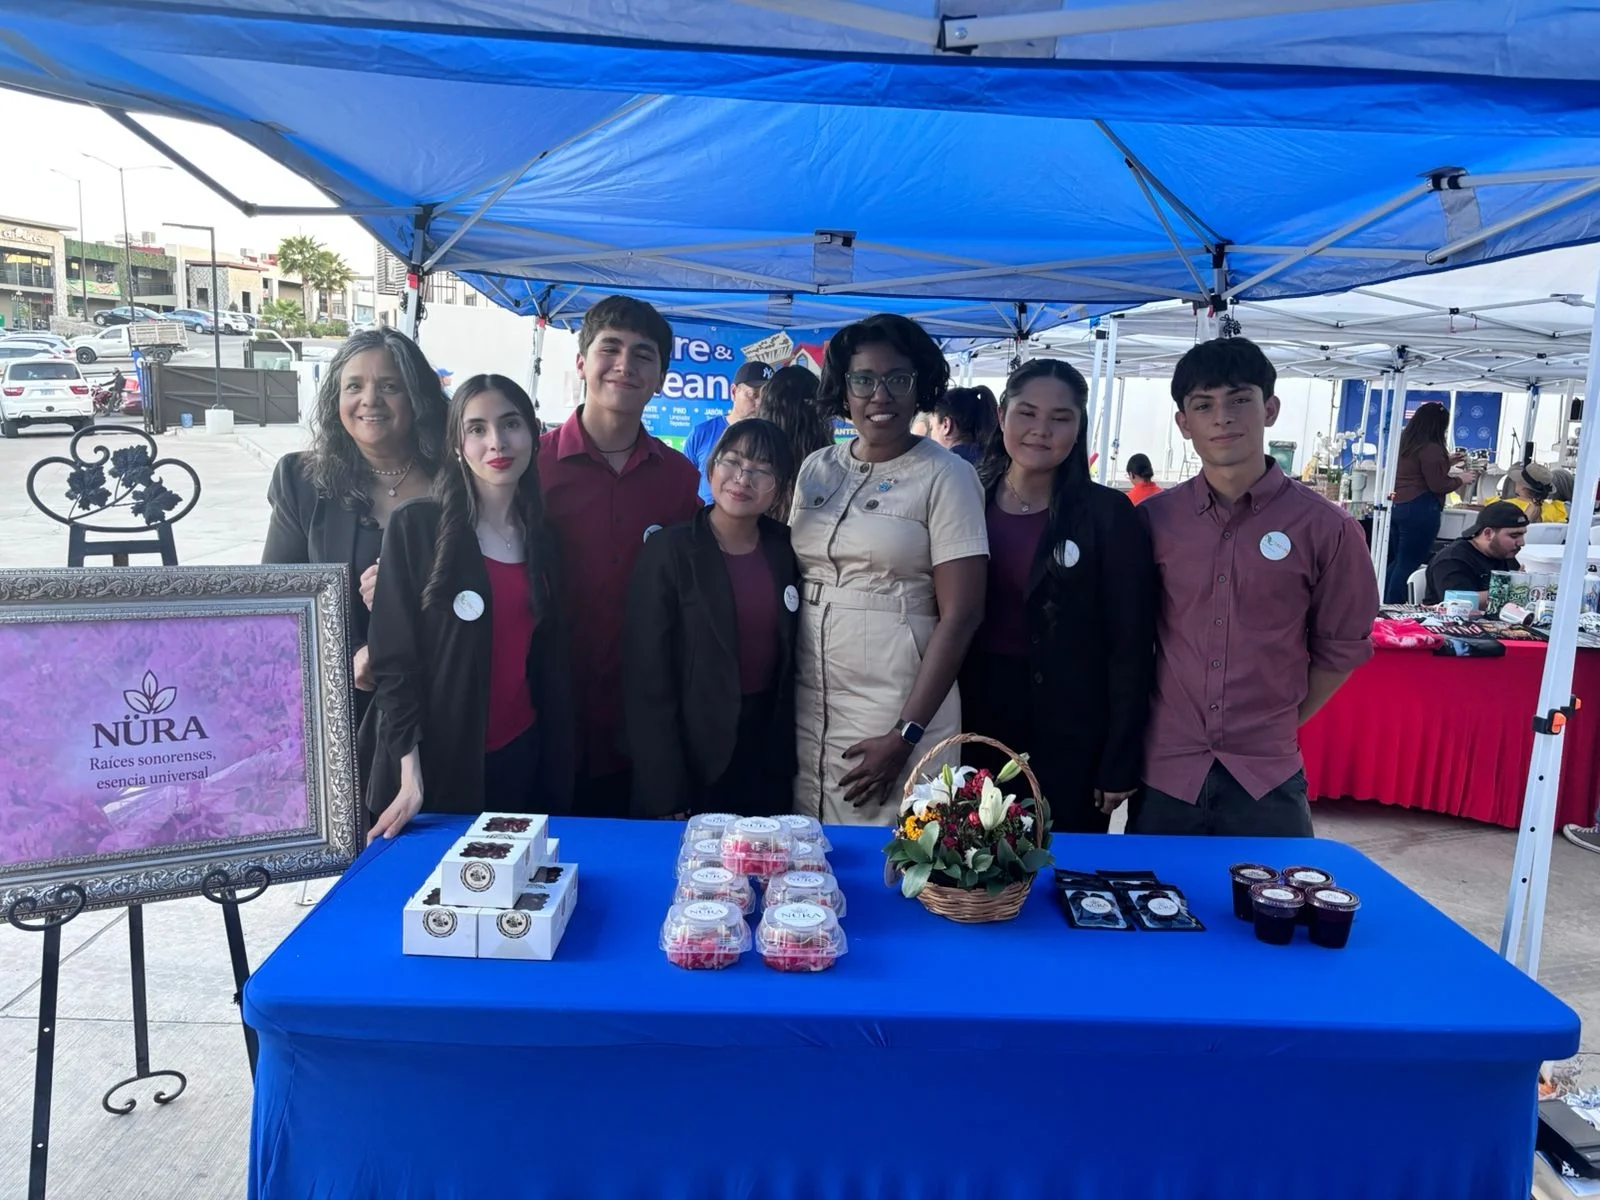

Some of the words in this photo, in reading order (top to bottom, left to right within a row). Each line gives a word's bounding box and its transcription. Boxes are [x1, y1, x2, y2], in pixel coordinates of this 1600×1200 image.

[672, 337, 710, 362] re
[714, 346, 733, 360] &
[656, 372, 729, 400] ean
[92, 714, 209, 749] NÜRA
[89, 755, 135, 771] Raíces
[138, 750, 217, 766] sonorenses,
[96, 772, 146, 790] esencia
